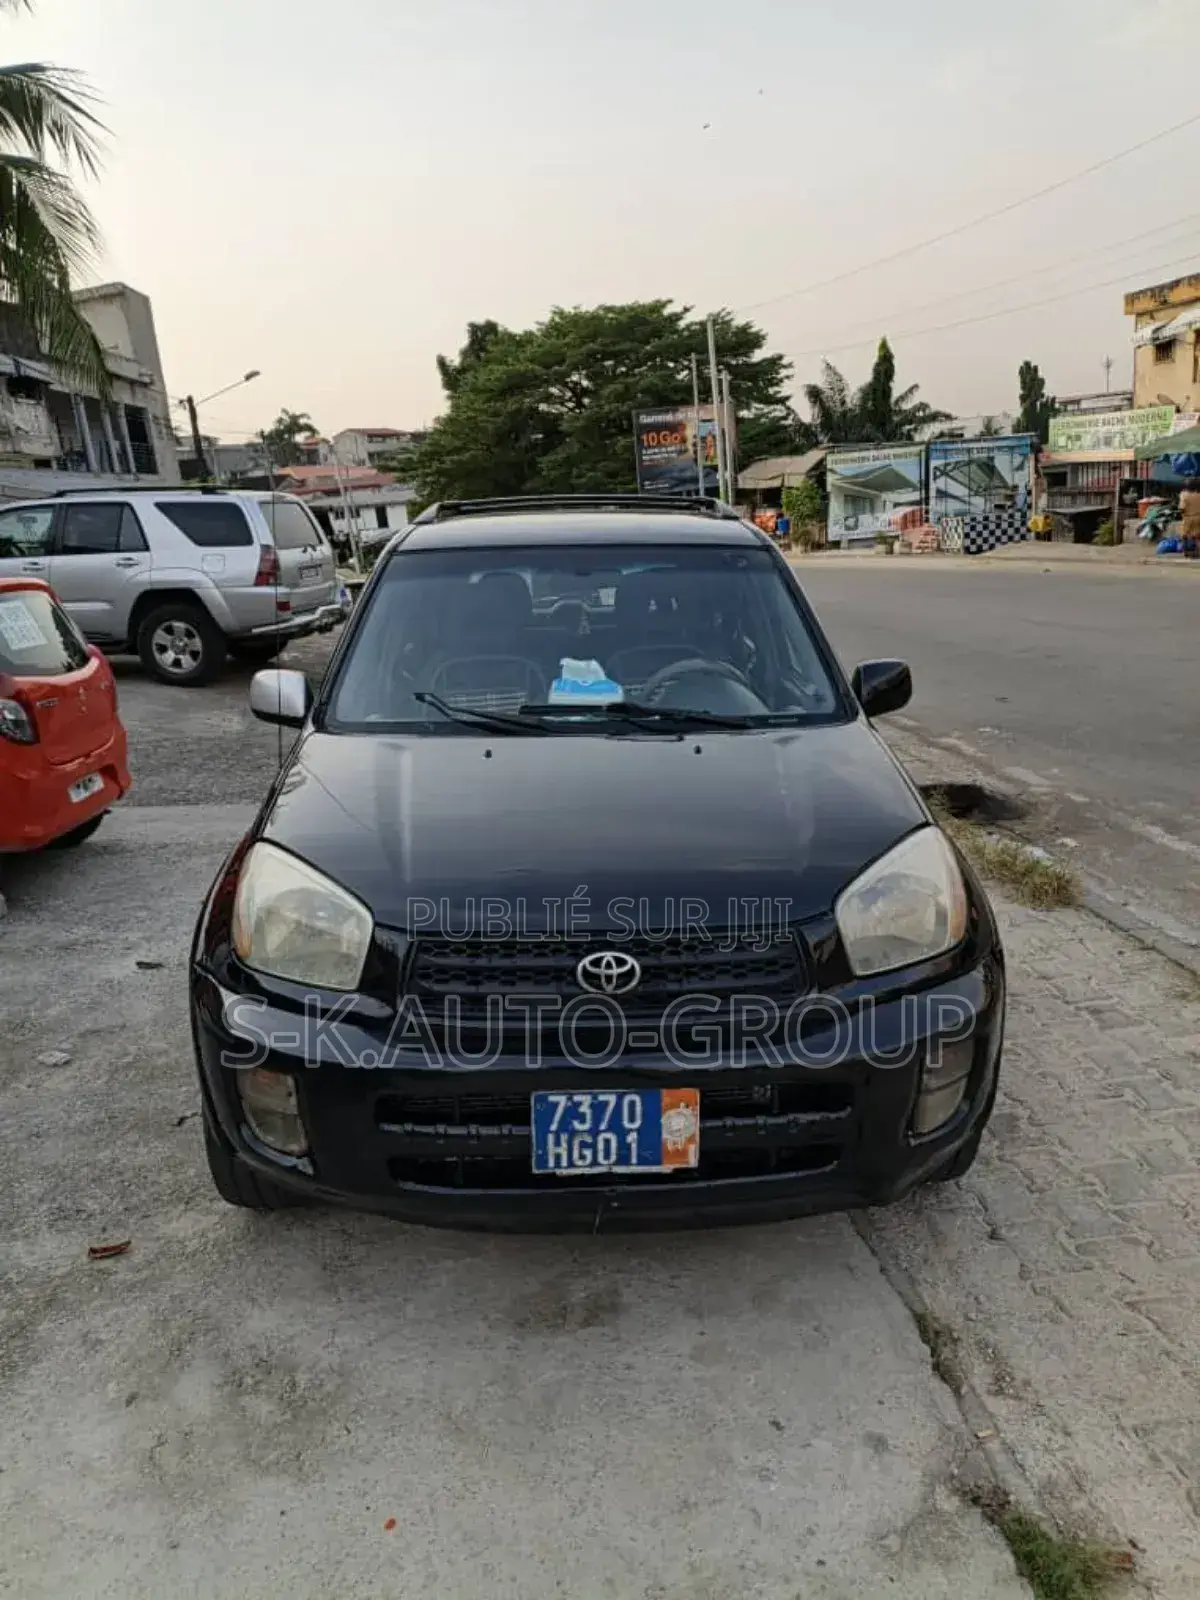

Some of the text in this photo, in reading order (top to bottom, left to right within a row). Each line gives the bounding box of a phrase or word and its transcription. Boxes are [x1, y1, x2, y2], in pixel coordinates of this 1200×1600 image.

[641, 430, 681, 448] 10 Go
[547, 1093, 643, 1131] 7370
[547, 1131, 639, 1168] HG01
